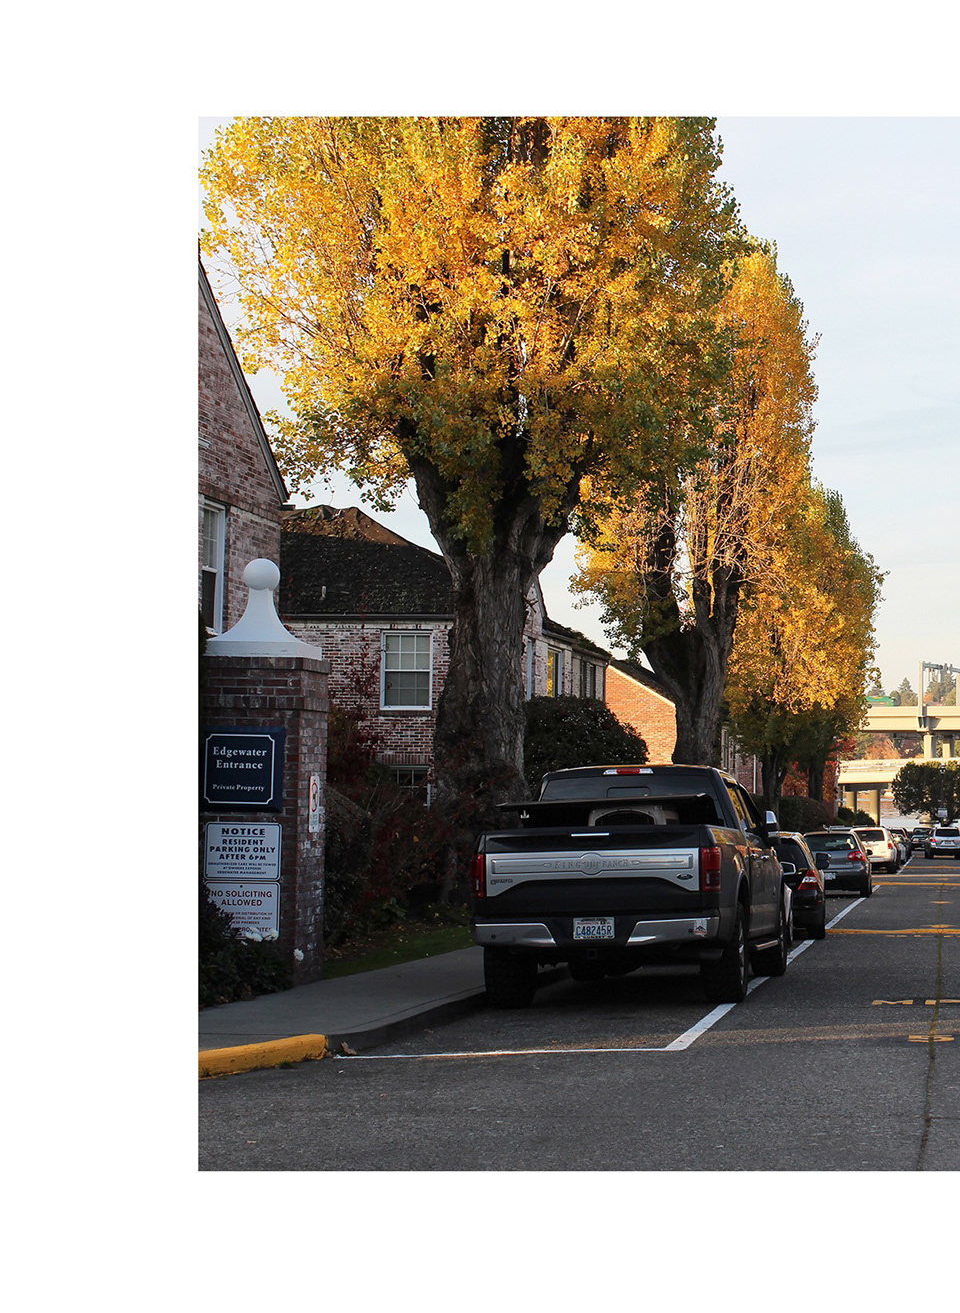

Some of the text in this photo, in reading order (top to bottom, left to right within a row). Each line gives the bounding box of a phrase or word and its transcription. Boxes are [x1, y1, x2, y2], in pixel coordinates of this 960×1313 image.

[213, 746, 267, 758] Edgewater
[216, 760, 263, 769] Entrance
[236, 784, 265, 792] Property
[554, 859, 628, 869] KING RANCH
[226, 890, 272, 898] SOLICITING
